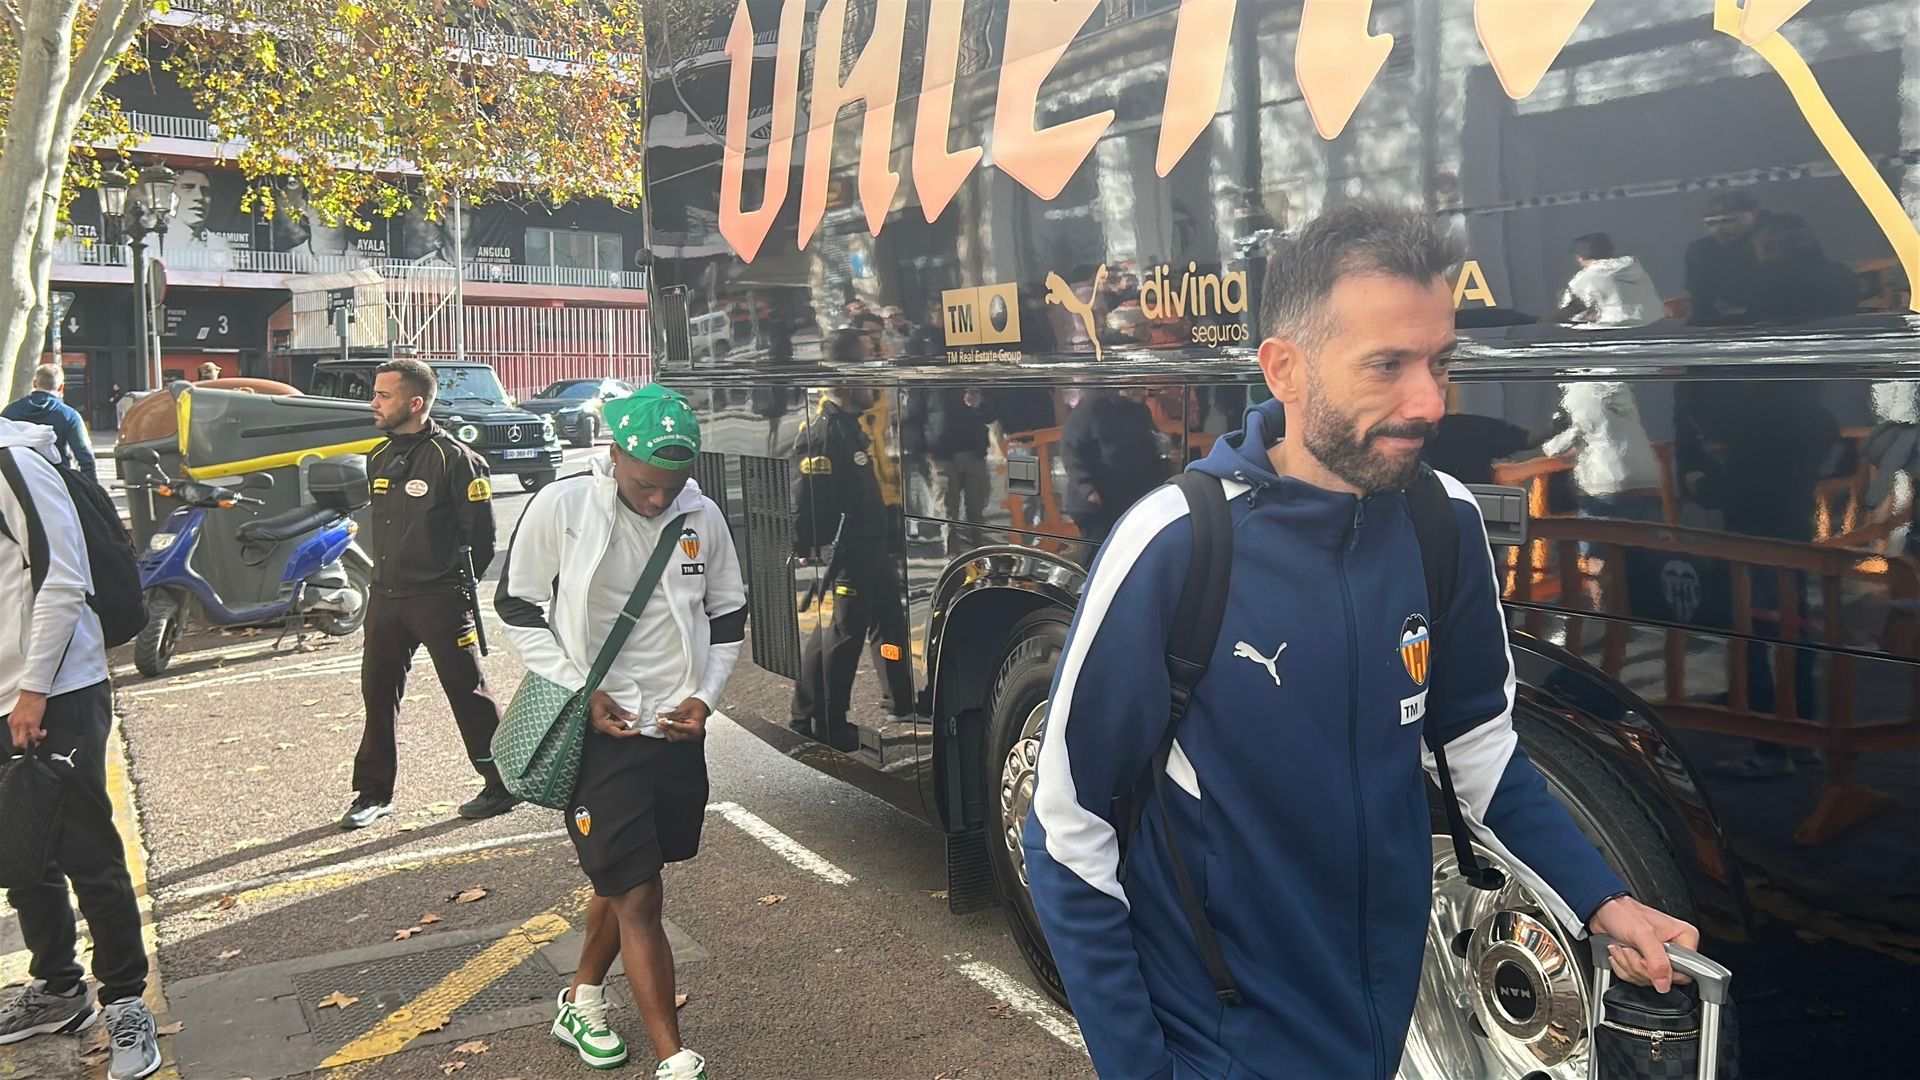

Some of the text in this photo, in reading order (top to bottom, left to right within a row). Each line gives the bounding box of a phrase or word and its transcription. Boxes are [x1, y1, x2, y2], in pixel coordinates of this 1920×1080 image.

[357, 239, 385, 251] AYALA
[477, 246, 511, 258] ANGULO
[1140, 260, 1248, 320] divina
[217, 315, 229, 334] 3
[947, 304, 973, 333] TM
[1191, 323, 1249, 348] seguros
[946, 348, 1022, 364] TM Real Estate Group
[1403, 702, 1419, 719] TM
[1499, 986, 1531, 999] MAN
